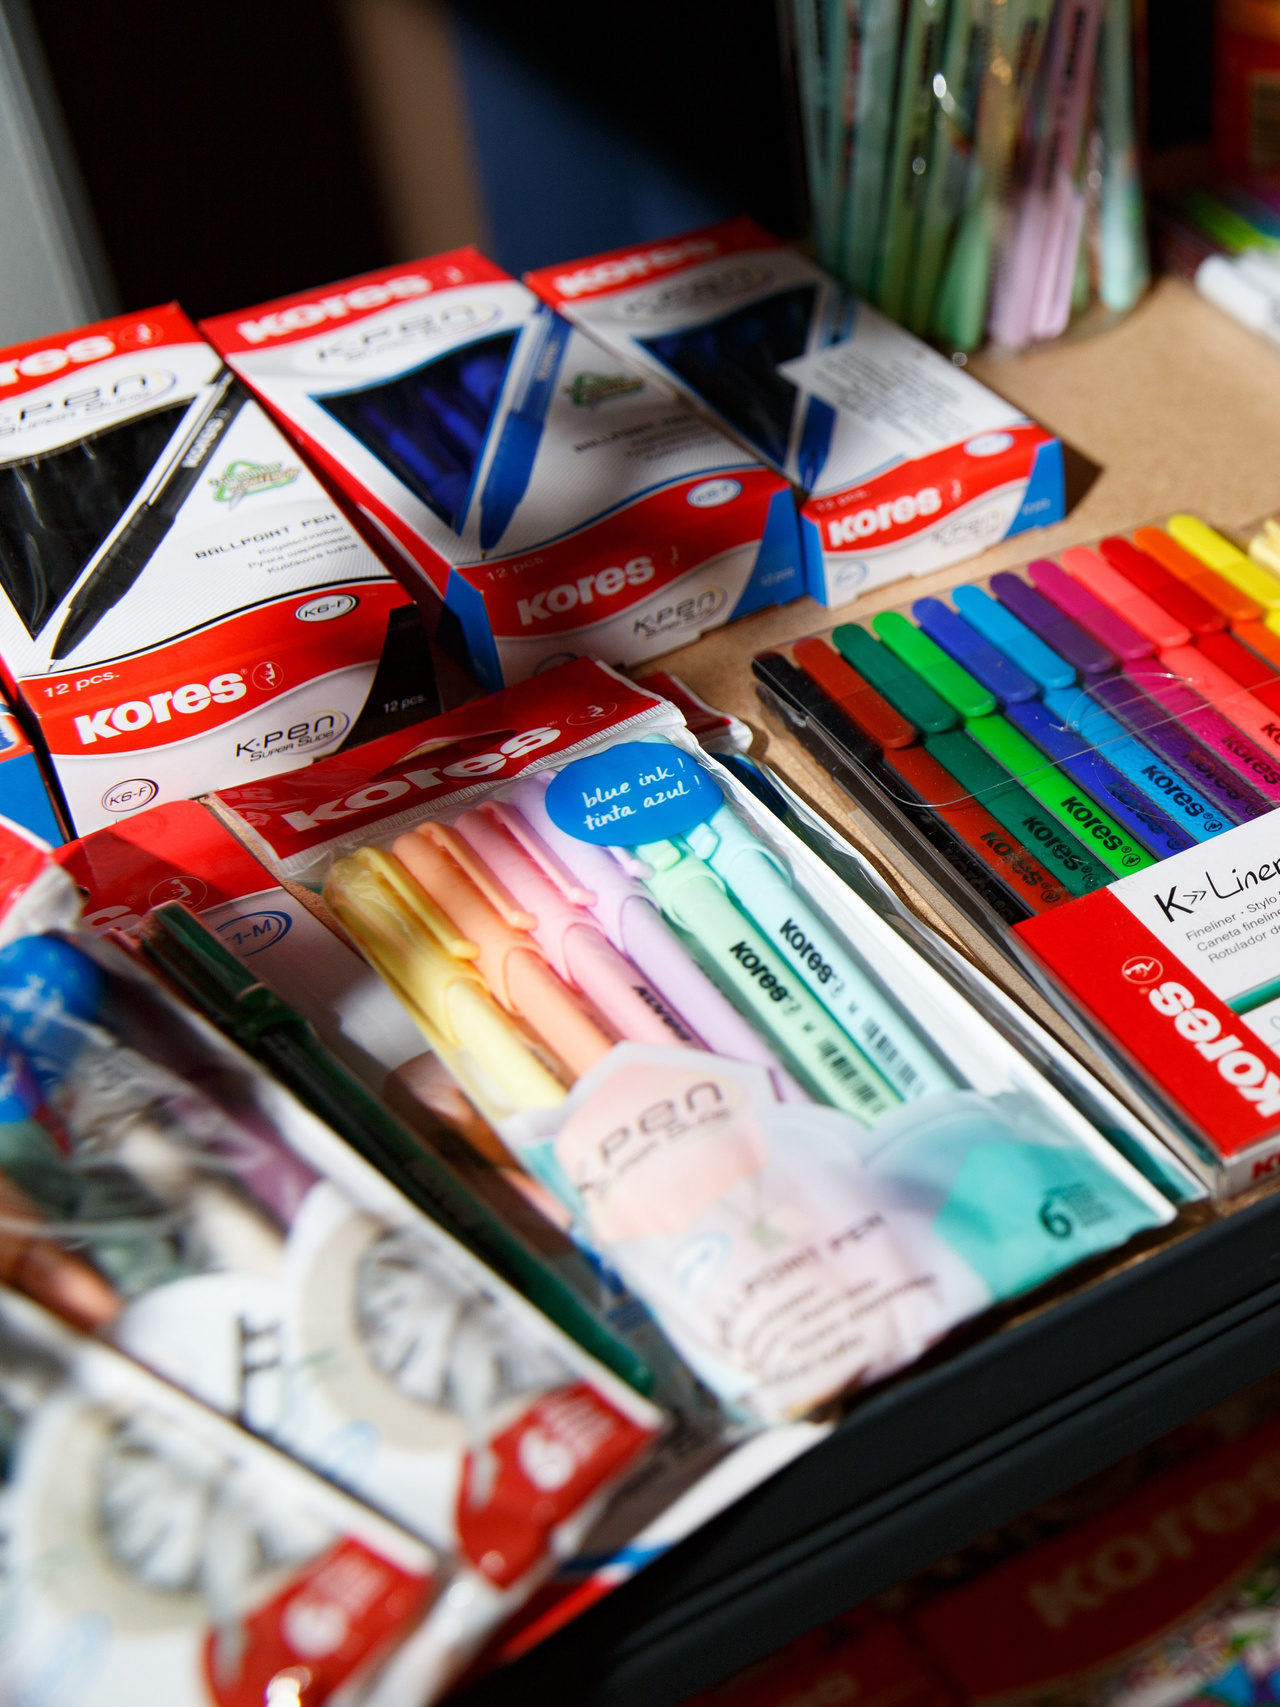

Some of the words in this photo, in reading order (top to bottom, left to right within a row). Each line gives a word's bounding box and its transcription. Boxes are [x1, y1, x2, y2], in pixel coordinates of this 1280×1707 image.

[0, 335, 116, 386] res
[195, 526, 290, 559] BALLPOINT
[301, 512, 338, 528] PEN
[304, 598, 347, 618] K6-F
[517, 556, 655, 626] Kores
[44, 683, 70, 698] 12
[76, 671, 120, 692] pcs.
[74, 672, 248, 745] Kores
[108, 785, 148, 807] K6-F
[281, 723, 562, 832] Kores
[582, 782, 632, 809] blue
[638, 766, 675, 787] ink
[1140, 764, 1206, 818] Kores
[583, 805, 637, 831] tinta
[642, 781, 691, 808] azul
[1060, 794, 1123, 853] Kores
[980, 831, 1044, 887] Kores
[1021, 814, 1085, 884] Kores
[1185, 912, 1237, 942] Fineliner
[1246, 895, 1278, 914] Stylo
[1196, 930, 1242, 953] Caneta
[729, 940, 789, 1003] Kores
[779, 917, 834, 984] Kores
[1207, 931, 1268, 964] Rotulador
[1038, 1187, 1075, 1242] 6
